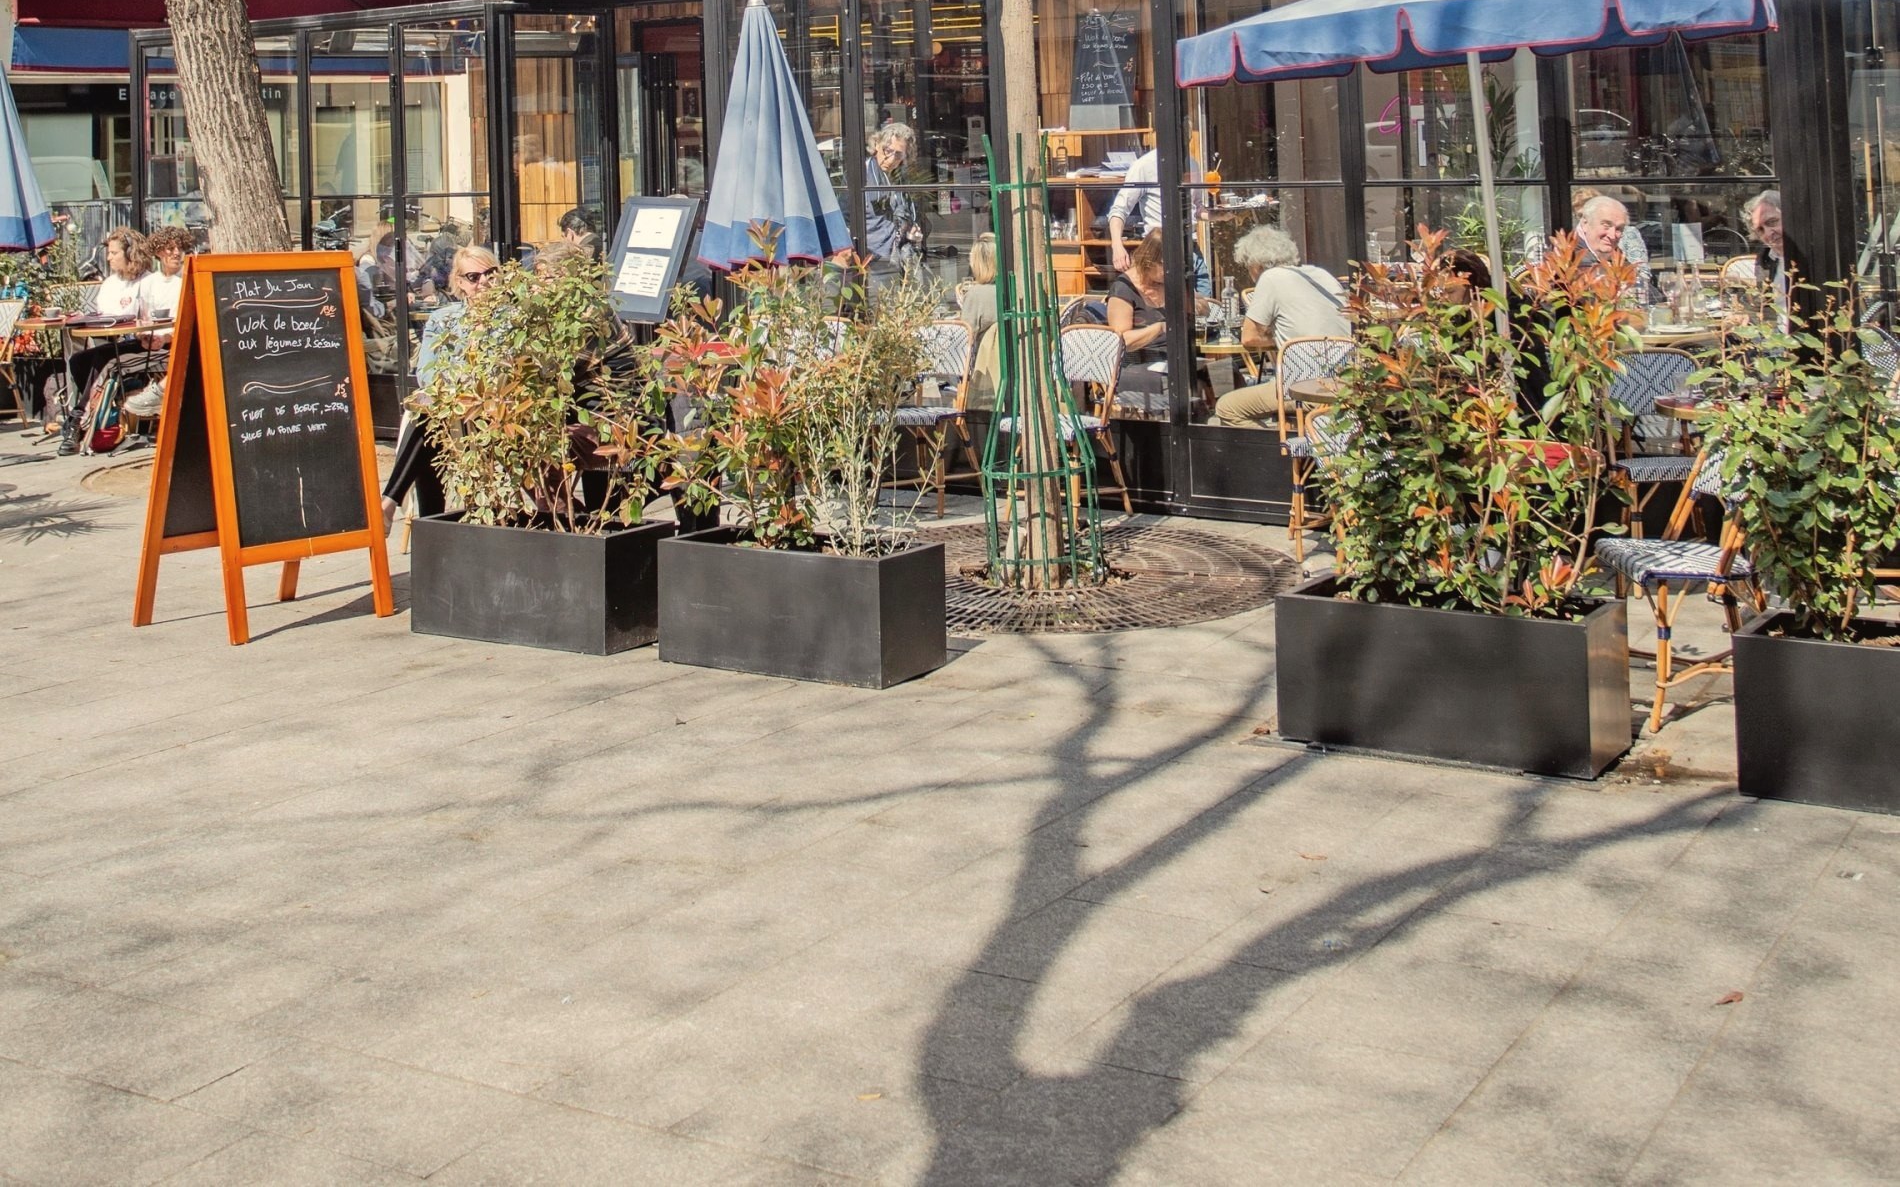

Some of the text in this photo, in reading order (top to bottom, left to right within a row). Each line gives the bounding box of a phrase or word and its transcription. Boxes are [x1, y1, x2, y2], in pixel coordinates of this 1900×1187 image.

[118, 88, 176, 101] Eace
[235, 314, 269, 335] Wok
[273, 314, 287, 331] de
[238, 338, 258, 351] aux
[265, 335, 303, 354] légumes
